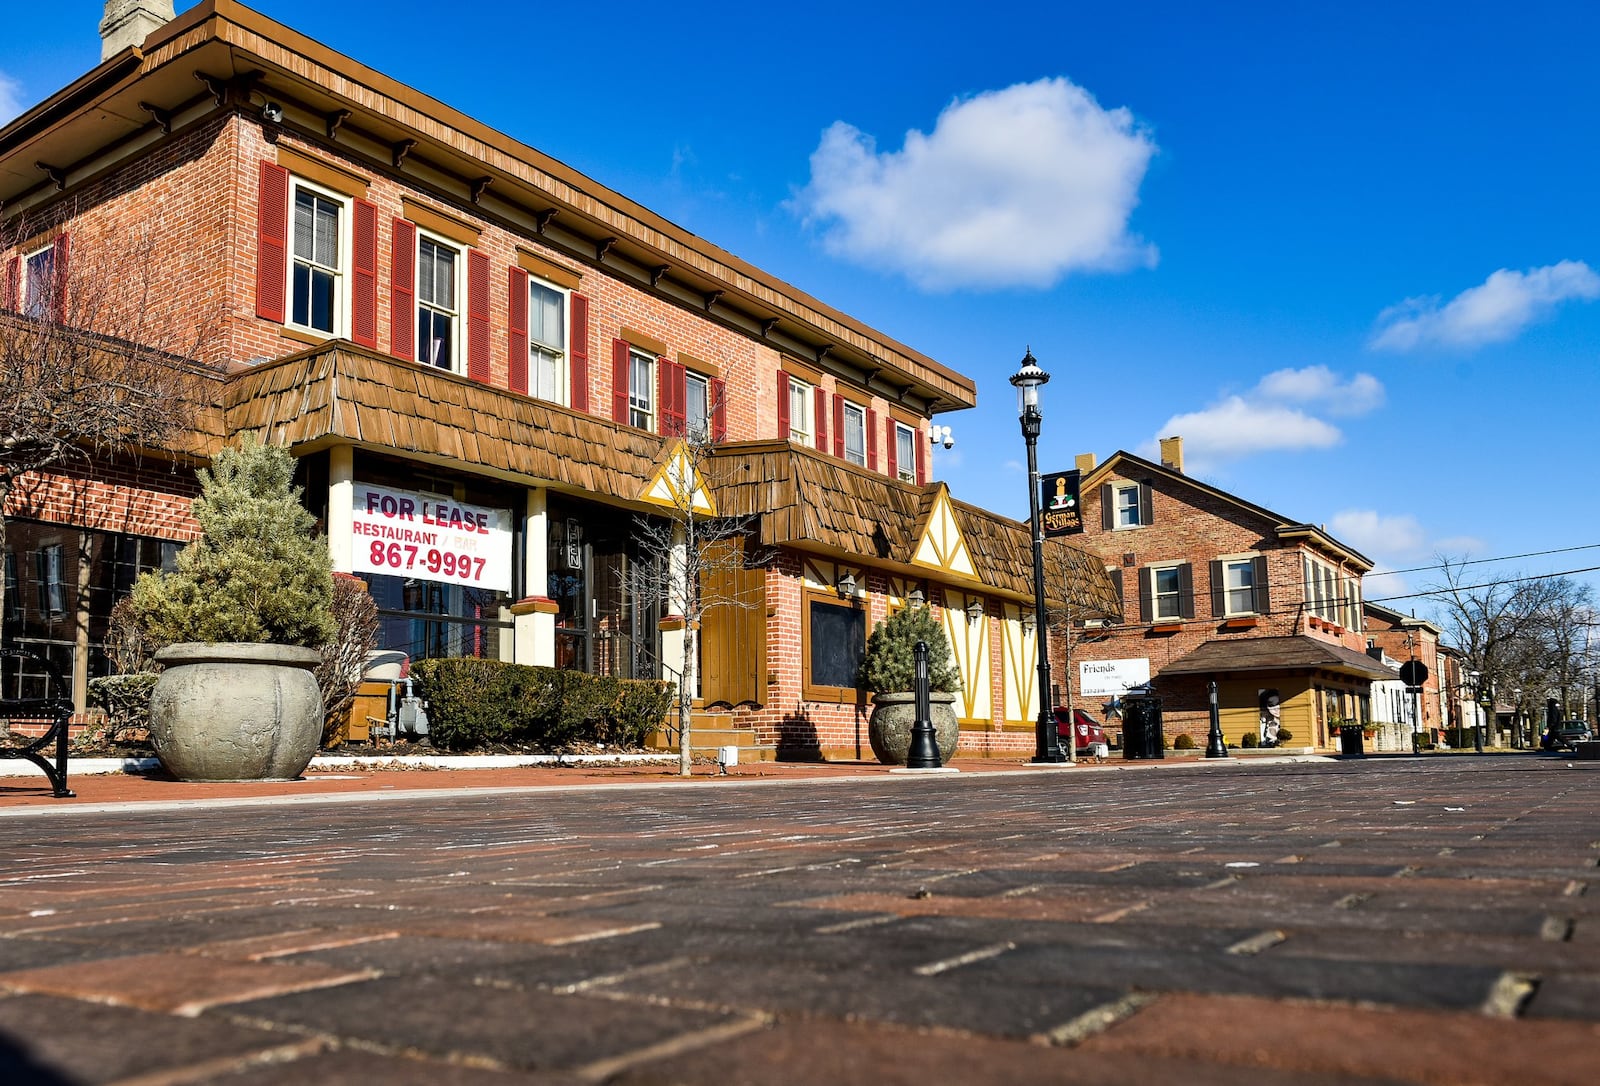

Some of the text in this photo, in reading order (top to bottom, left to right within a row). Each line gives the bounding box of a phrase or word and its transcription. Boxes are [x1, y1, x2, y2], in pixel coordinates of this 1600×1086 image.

[366, 491, 489, 535] FOR LEASE
[1045, 511, 1076, 524] German
[1051, 517, 1080, 529] Village
[353, 520, 438, 546] RESTAURANT
[454, 535, 478, 551] BAR
[369, 540, 487, 581] 867-9997
[1083, 662, 1116, 674] Friends
